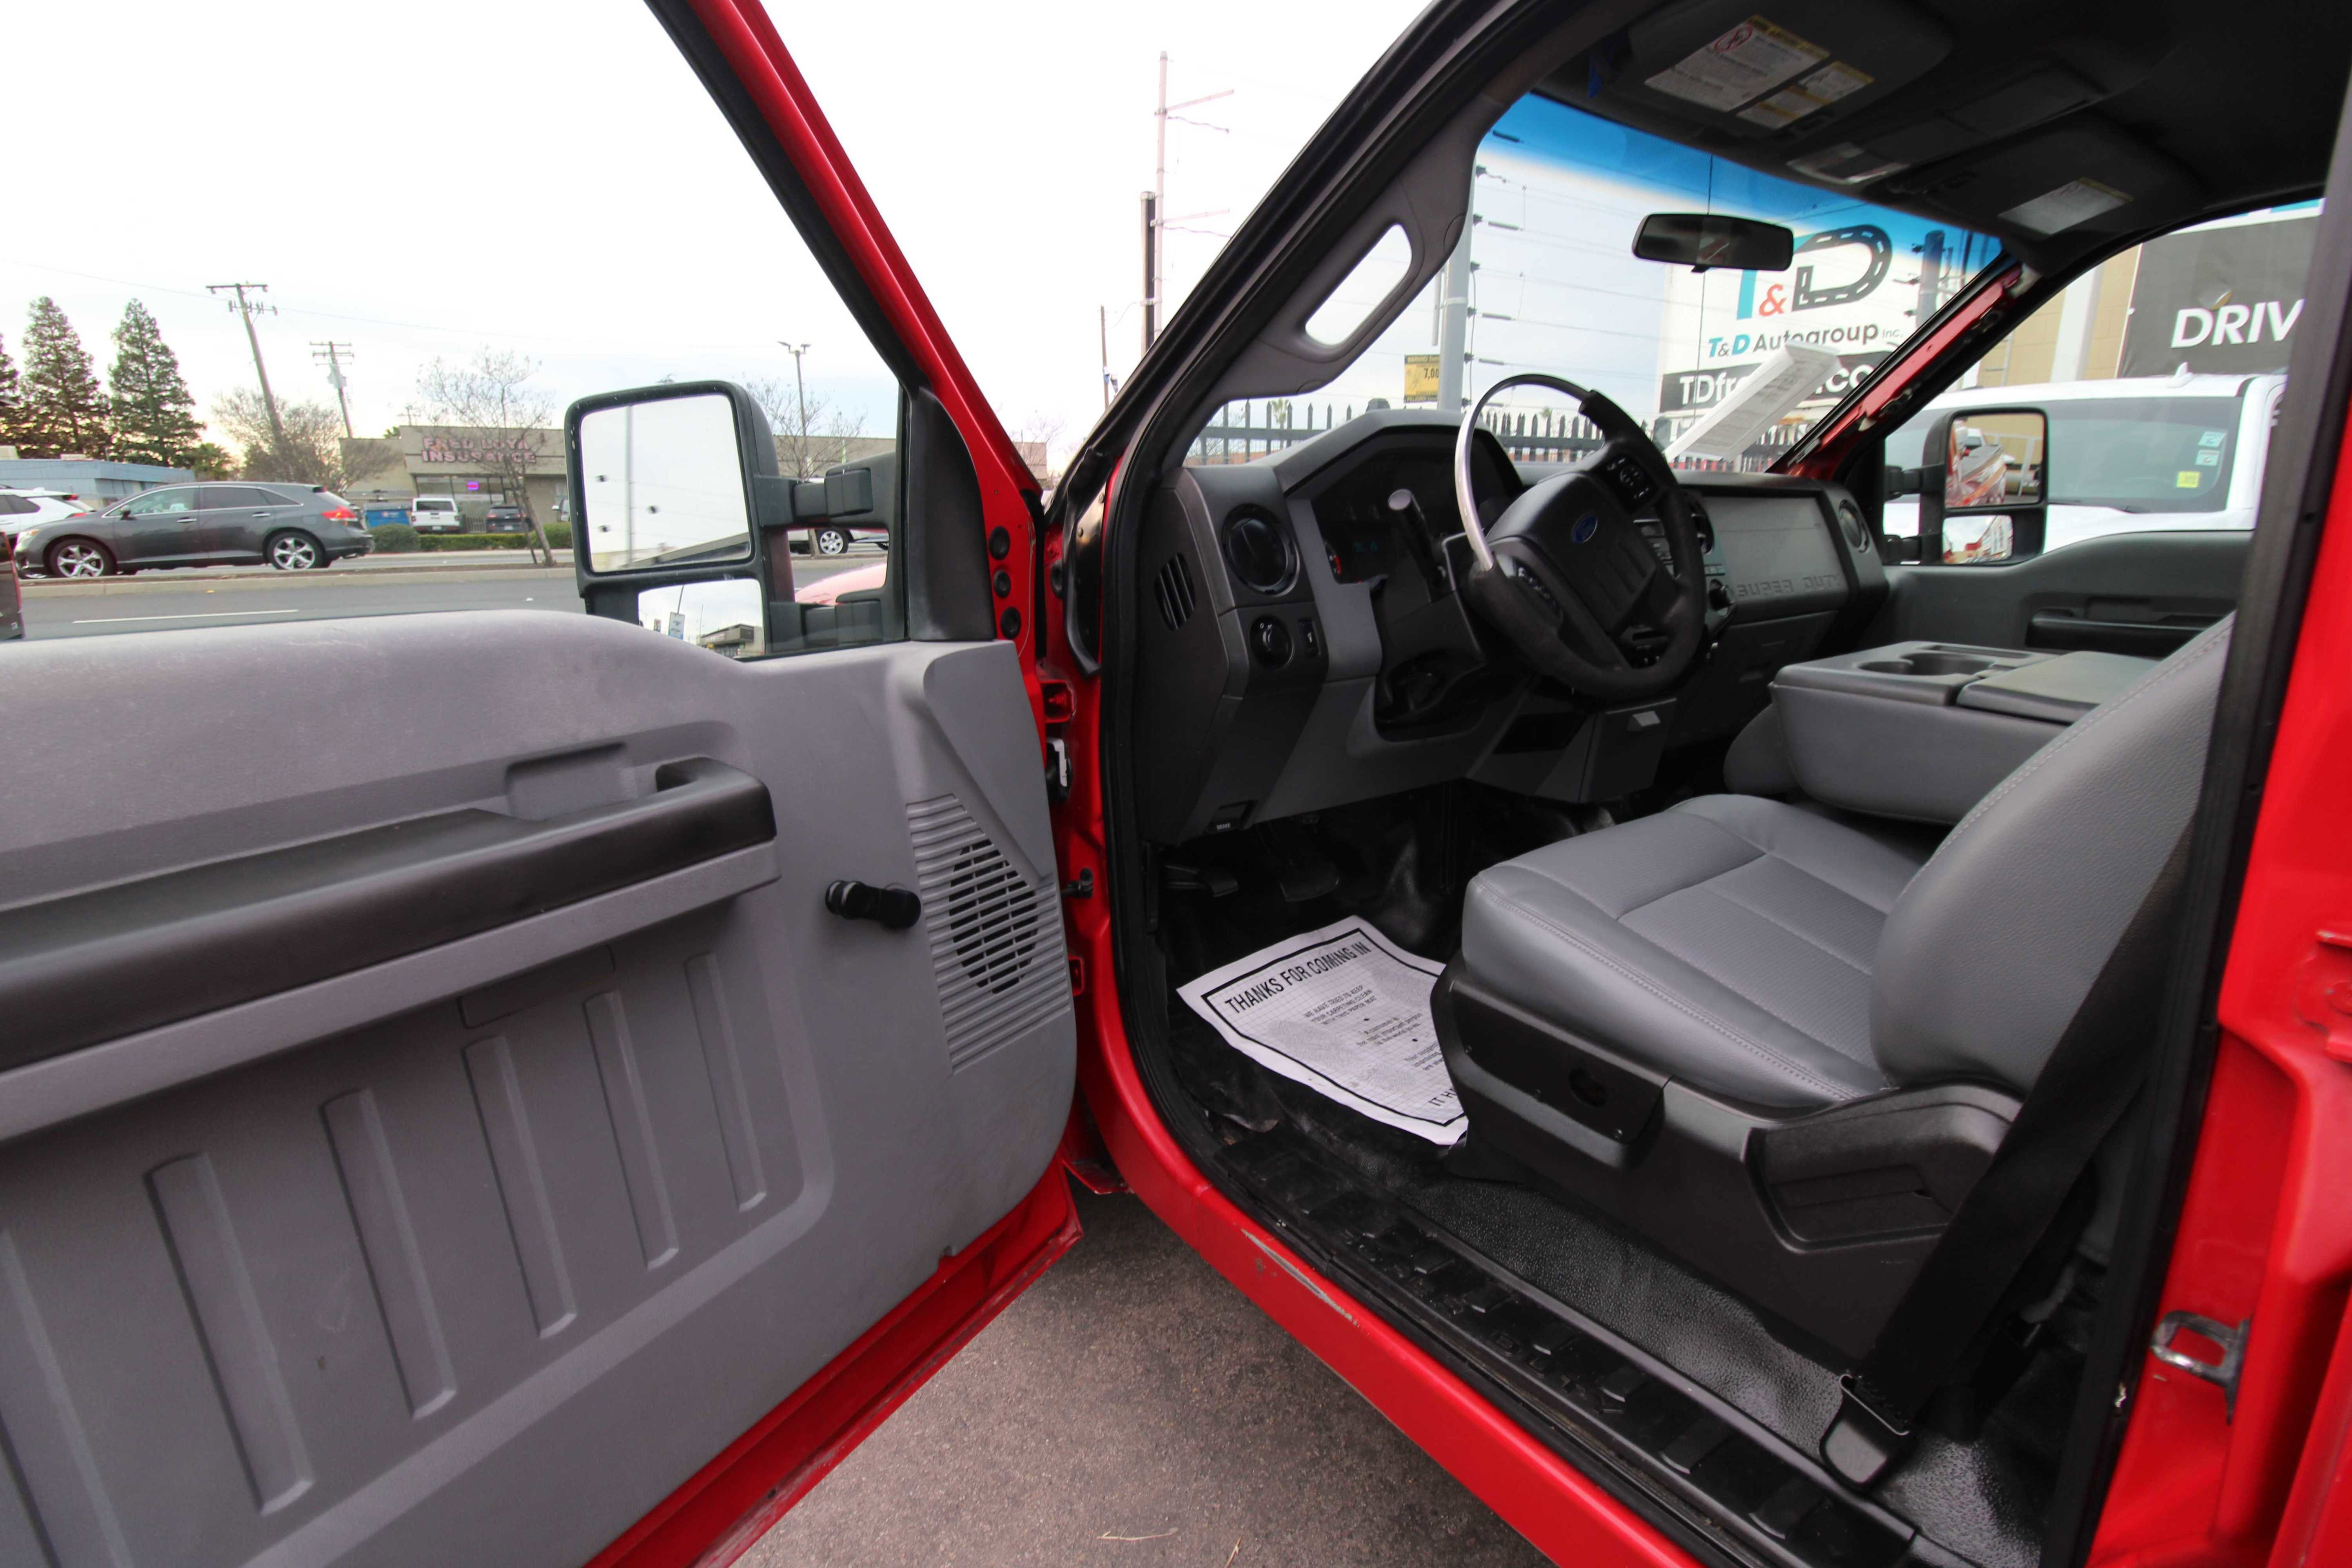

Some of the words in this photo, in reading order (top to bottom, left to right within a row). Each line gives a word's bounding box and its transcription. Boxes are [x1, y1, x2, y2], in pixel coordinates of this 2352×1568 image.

[1709, 334, 1750, 358] T&D
[1225, 978, 1284, 1013] THANKS
[1280, 966, 1312, 986] FOR
[1307, 947, 1357, 974] COMING
[1351, 941, 1372, 956] IN
[1428, 1097, 1446, 1106] IT
